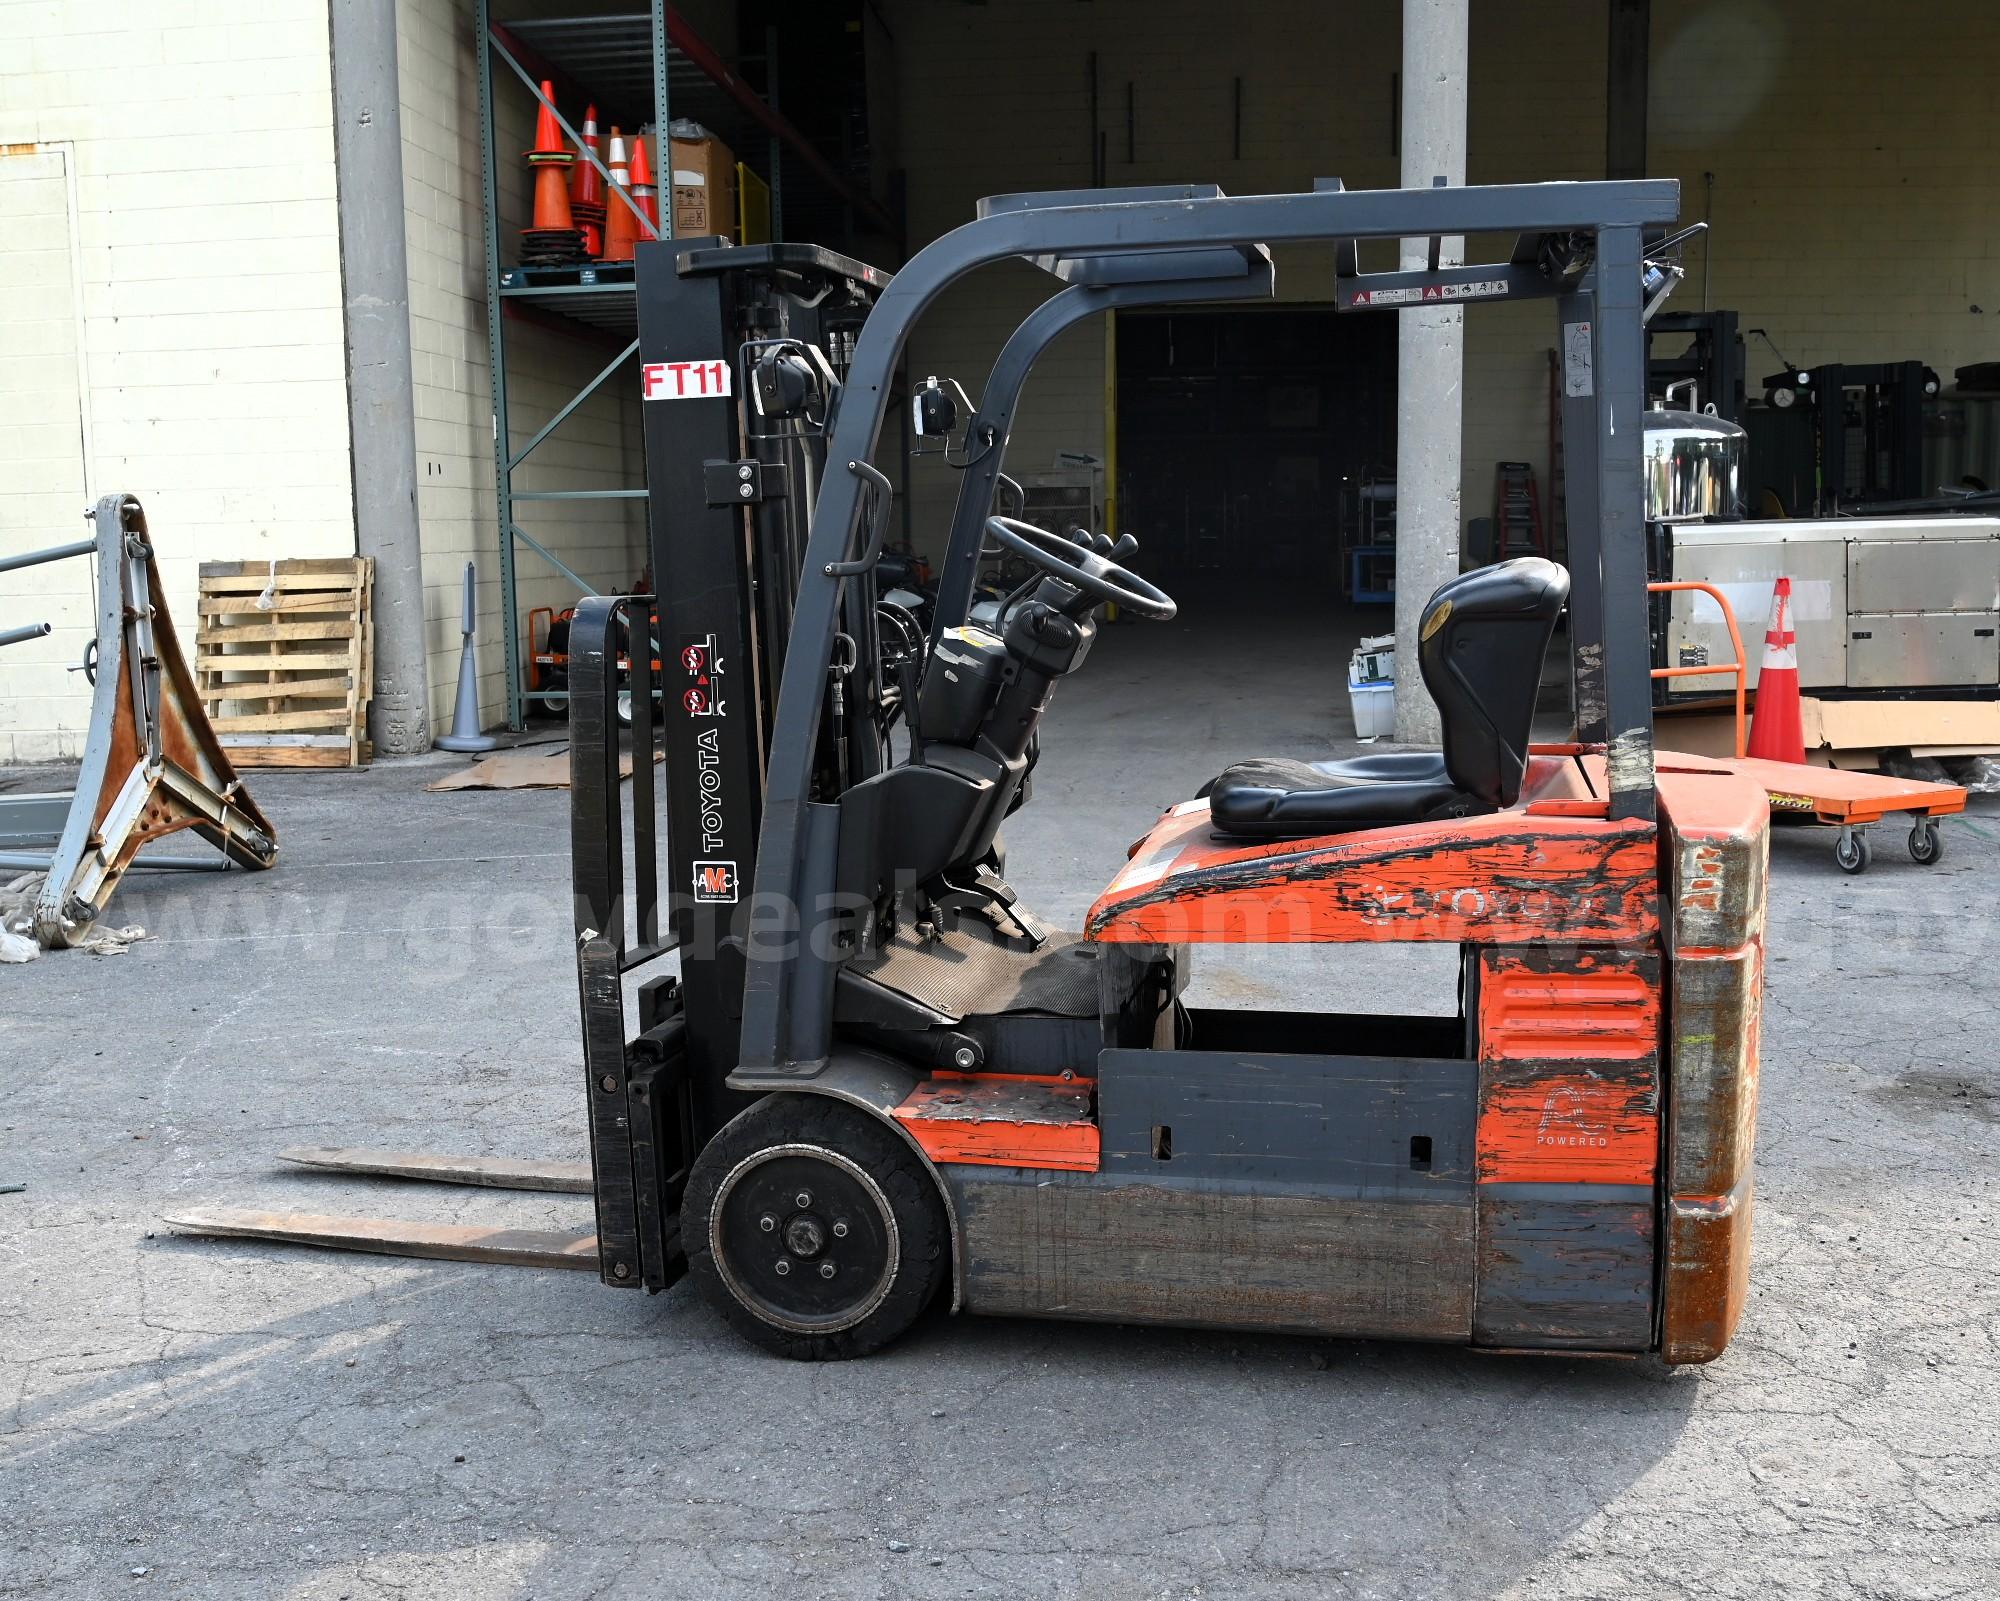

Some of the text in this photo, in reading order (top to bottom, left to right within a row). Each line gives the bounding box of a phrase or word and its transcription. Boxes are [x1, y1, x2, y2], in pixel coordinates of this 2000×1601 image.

[644, 362, 723, 397] FT11
[698, 728, 723, 853] TOYOTA
[697, 867, 733, 893] AMC
[1432, 887, 1597, 918] TOYO
[1537, 1136, 1607, 1147] POWERED
